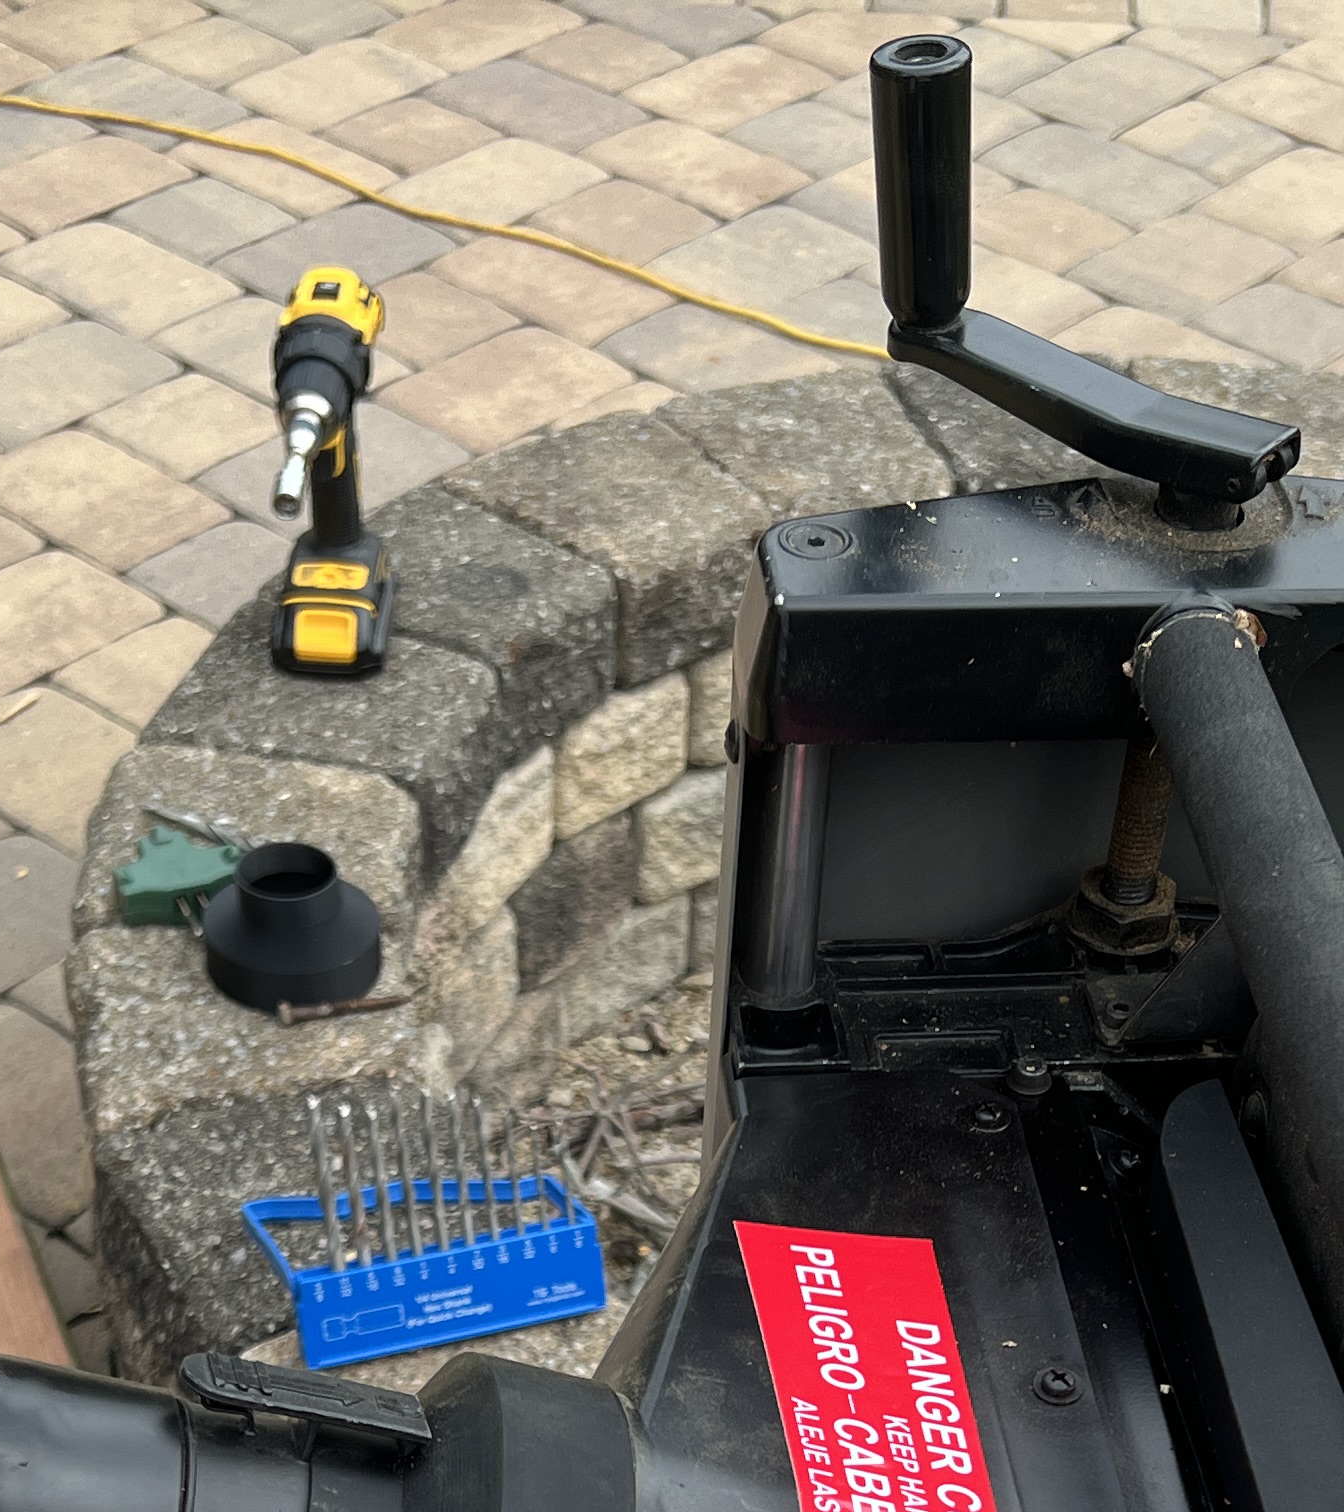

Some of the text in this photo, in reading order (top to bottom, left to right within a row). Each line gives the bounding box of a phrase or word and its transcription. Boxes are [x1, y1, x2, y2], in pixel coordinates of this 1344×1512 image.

[790, 1244, 865, 1390] PELIGRO
[791, 1396, 831, 1466] ALEJE
[882, 1414, 920, 1473] KEEP
[895, 1319, 973, 1475] DANGER
